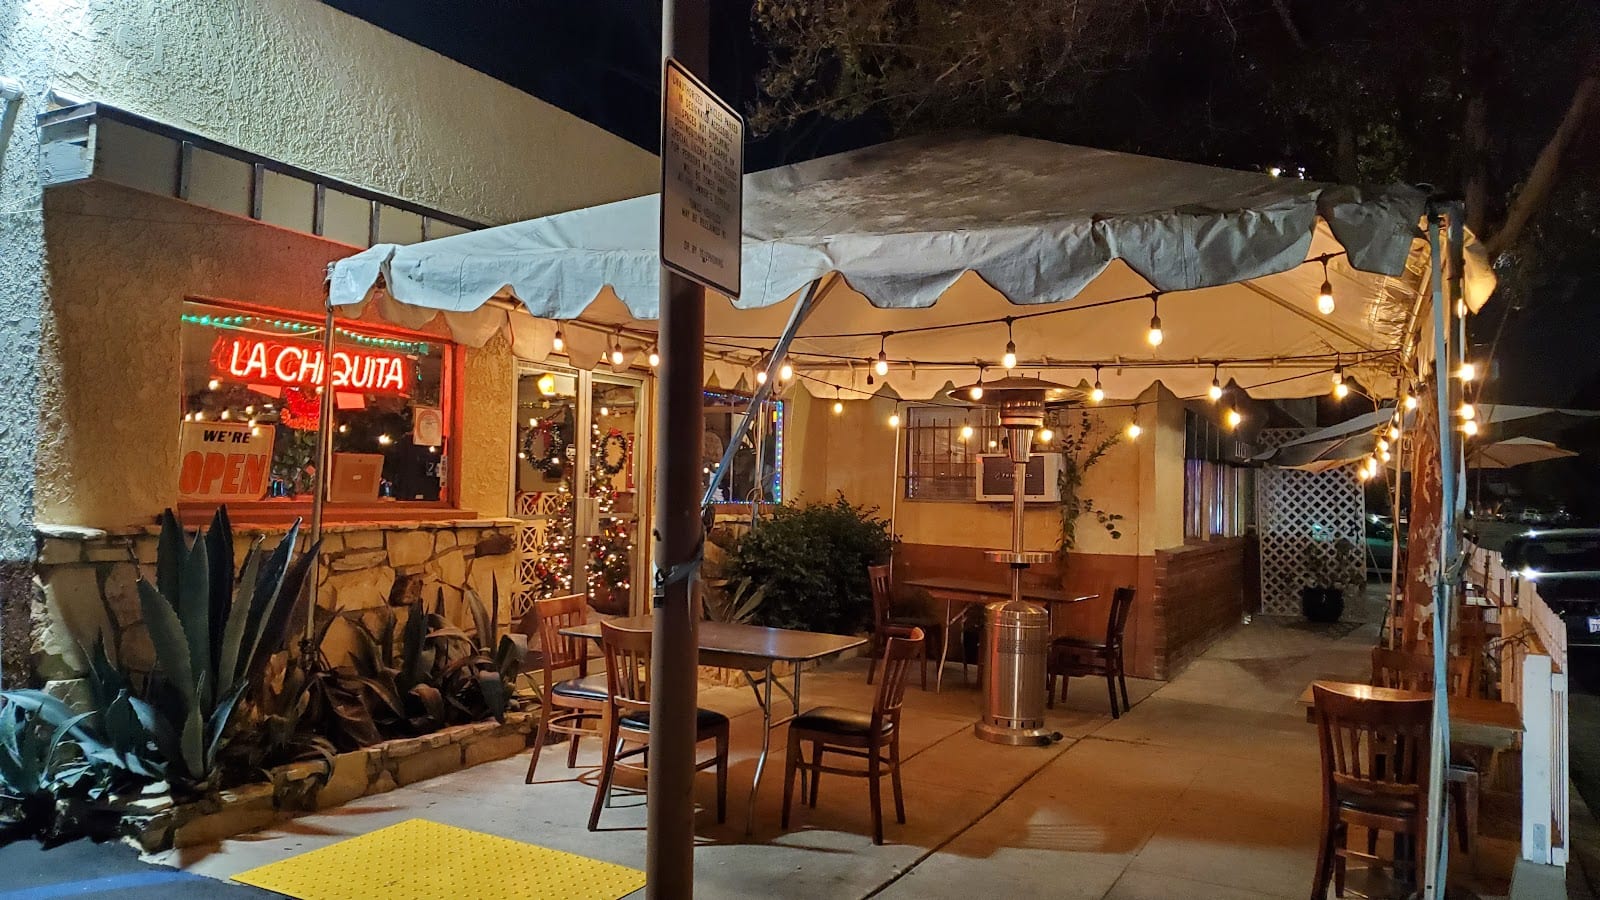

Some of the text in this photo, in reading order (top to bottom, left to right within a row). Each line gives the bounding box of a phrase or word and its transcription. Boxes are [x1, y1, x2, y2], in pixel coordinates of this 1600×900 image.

[229, 340, 404, 389] LA CHIQUITA
[203, 429, 251, 444] WE'RE
[179, 450, 267, 495] OPEN
